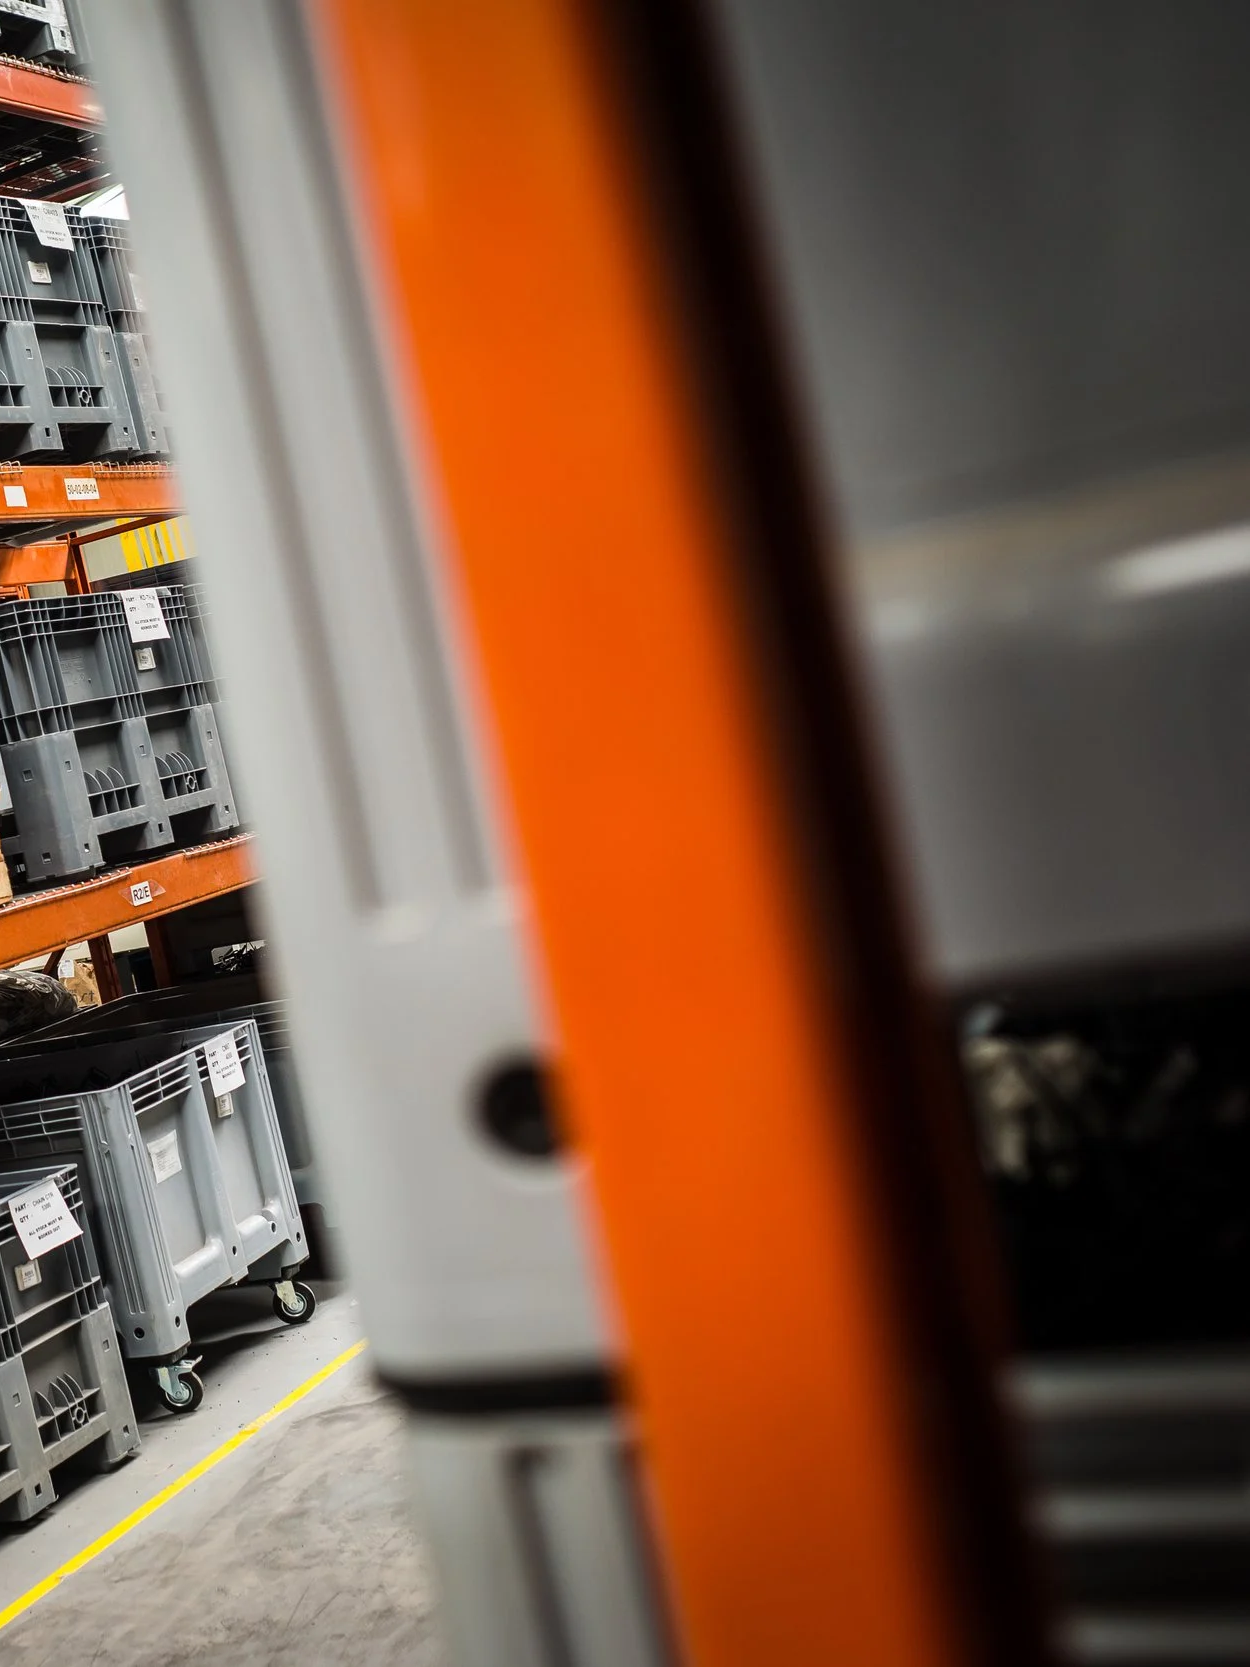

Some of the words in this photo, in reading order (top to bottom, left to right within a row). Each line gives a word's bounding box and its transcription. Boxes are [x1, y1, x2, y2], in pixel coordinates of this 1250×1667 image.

[133, 886, 150, 901] R2/E
[15, 1203, 26, 1214] PART
[20, 1215, 29, 1223] QTY
